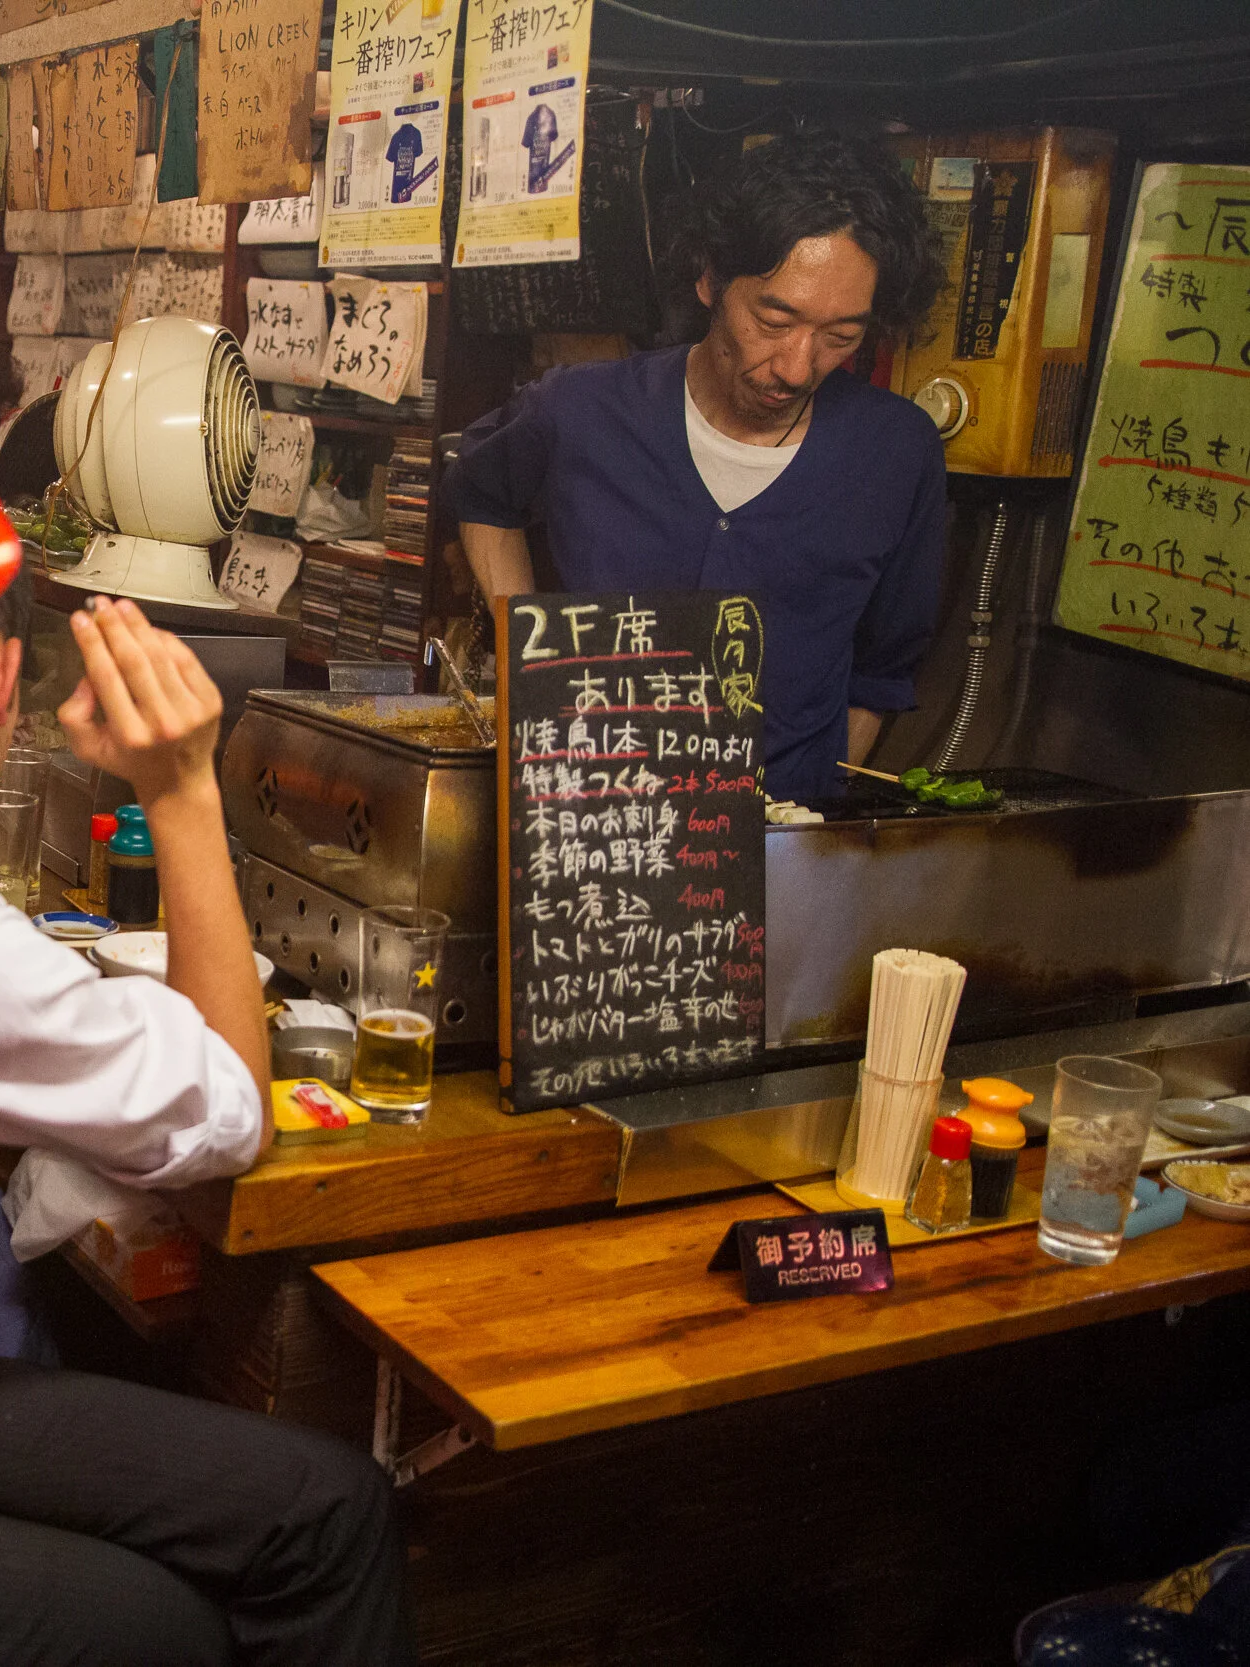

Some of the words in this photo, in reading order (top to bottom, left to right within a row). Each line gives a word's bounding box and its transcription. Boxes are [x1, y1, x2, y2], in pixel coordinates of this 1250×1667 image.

[218, 24, 260, 54] LION
[267, 14, 311, 49] CREEK
[340, 7, 384, 40] キリン
[337, 28, 452, 76] 一番搾りフェア
[514, 596, 657, 660] 2F席
[567, 662, 714, 726] あります
[516, 716, 647, 765] 焼鳥1本
[657, 727, 753, 768] 120円より
[520, 762, 665, 800] 特製つくね
[525, 799, 680, 839] 本日のお刺身
[687, 807, 731, 835] 600円
[527, 831, 675, 888] 季節の野菜
[524, 881, 653, 931] もつ煮込
[678, 884, 725, 911] 400円
[532, 911, 747, 967] トマトとガリのサラダ
[526, 956, 717, 1004] いぶりがっこチーズ
[755, 1224, 878, 1267] 御予約席
[777, 1262, 862, 1286] RESERVED
